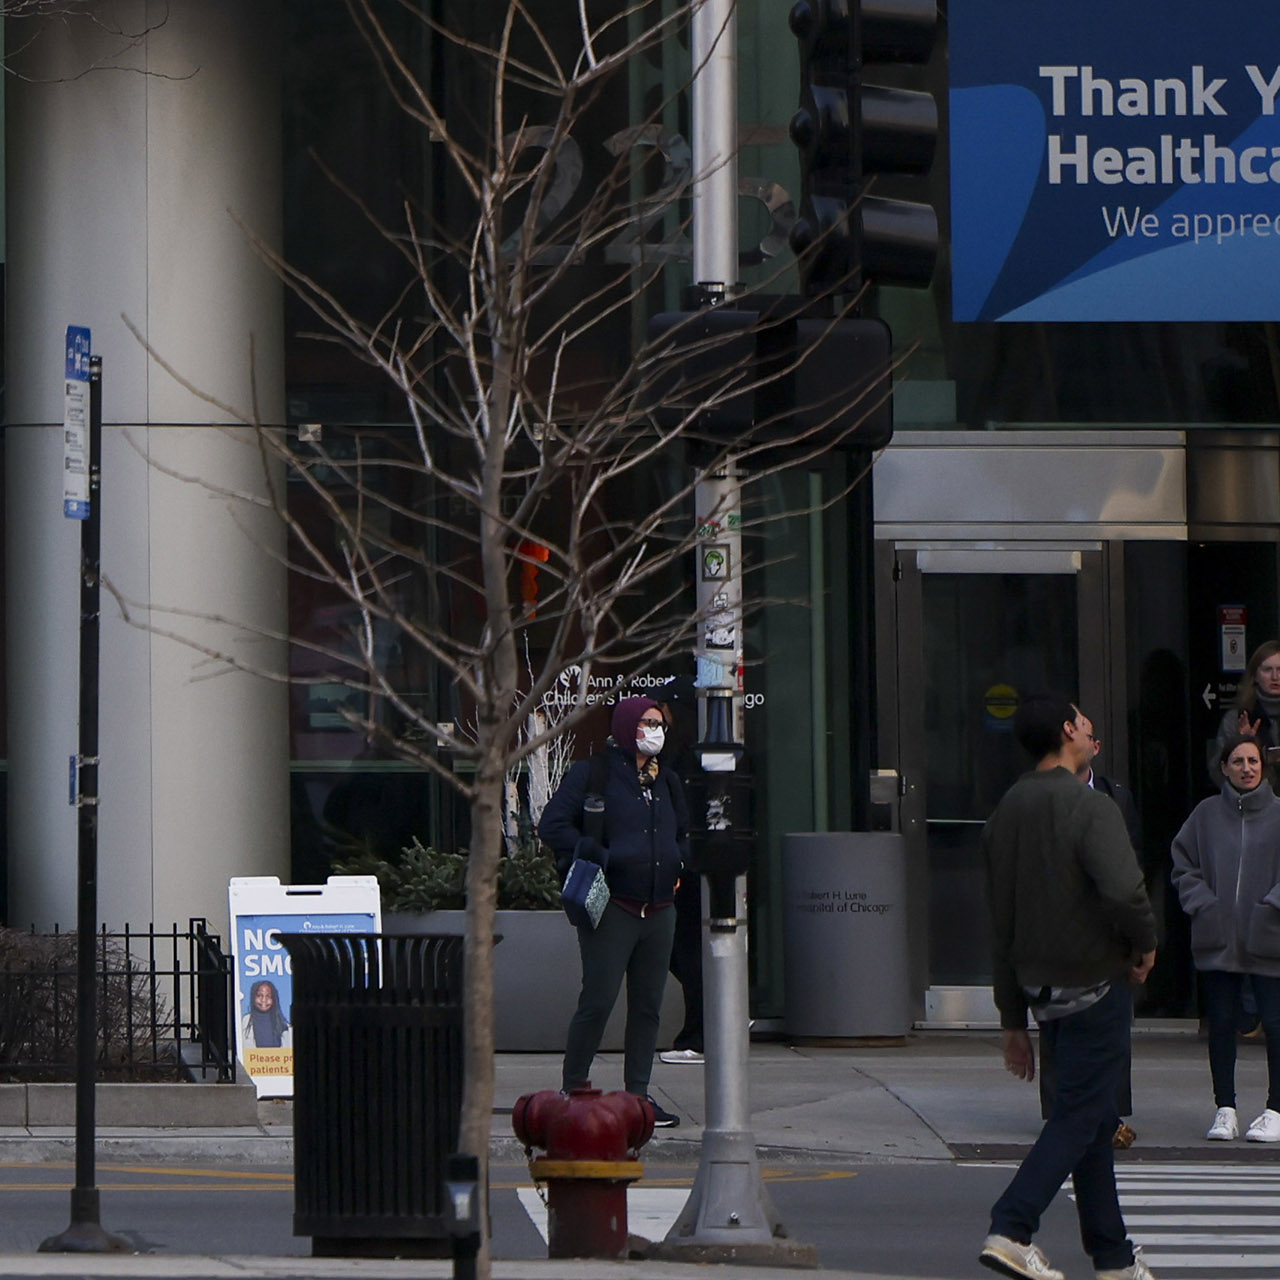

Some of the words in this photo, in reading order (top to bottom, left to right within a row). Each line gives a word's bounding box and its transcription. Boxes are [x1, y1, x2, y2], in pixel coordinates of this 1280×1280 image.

[1039, 66, 1228, 116] Thank
[1102, 206, 1159, 237] We
[588, 674, 613, 688] Ann
[249, 1054, 281, 1063] Please
[250, 1065, 290, 1077] patients
